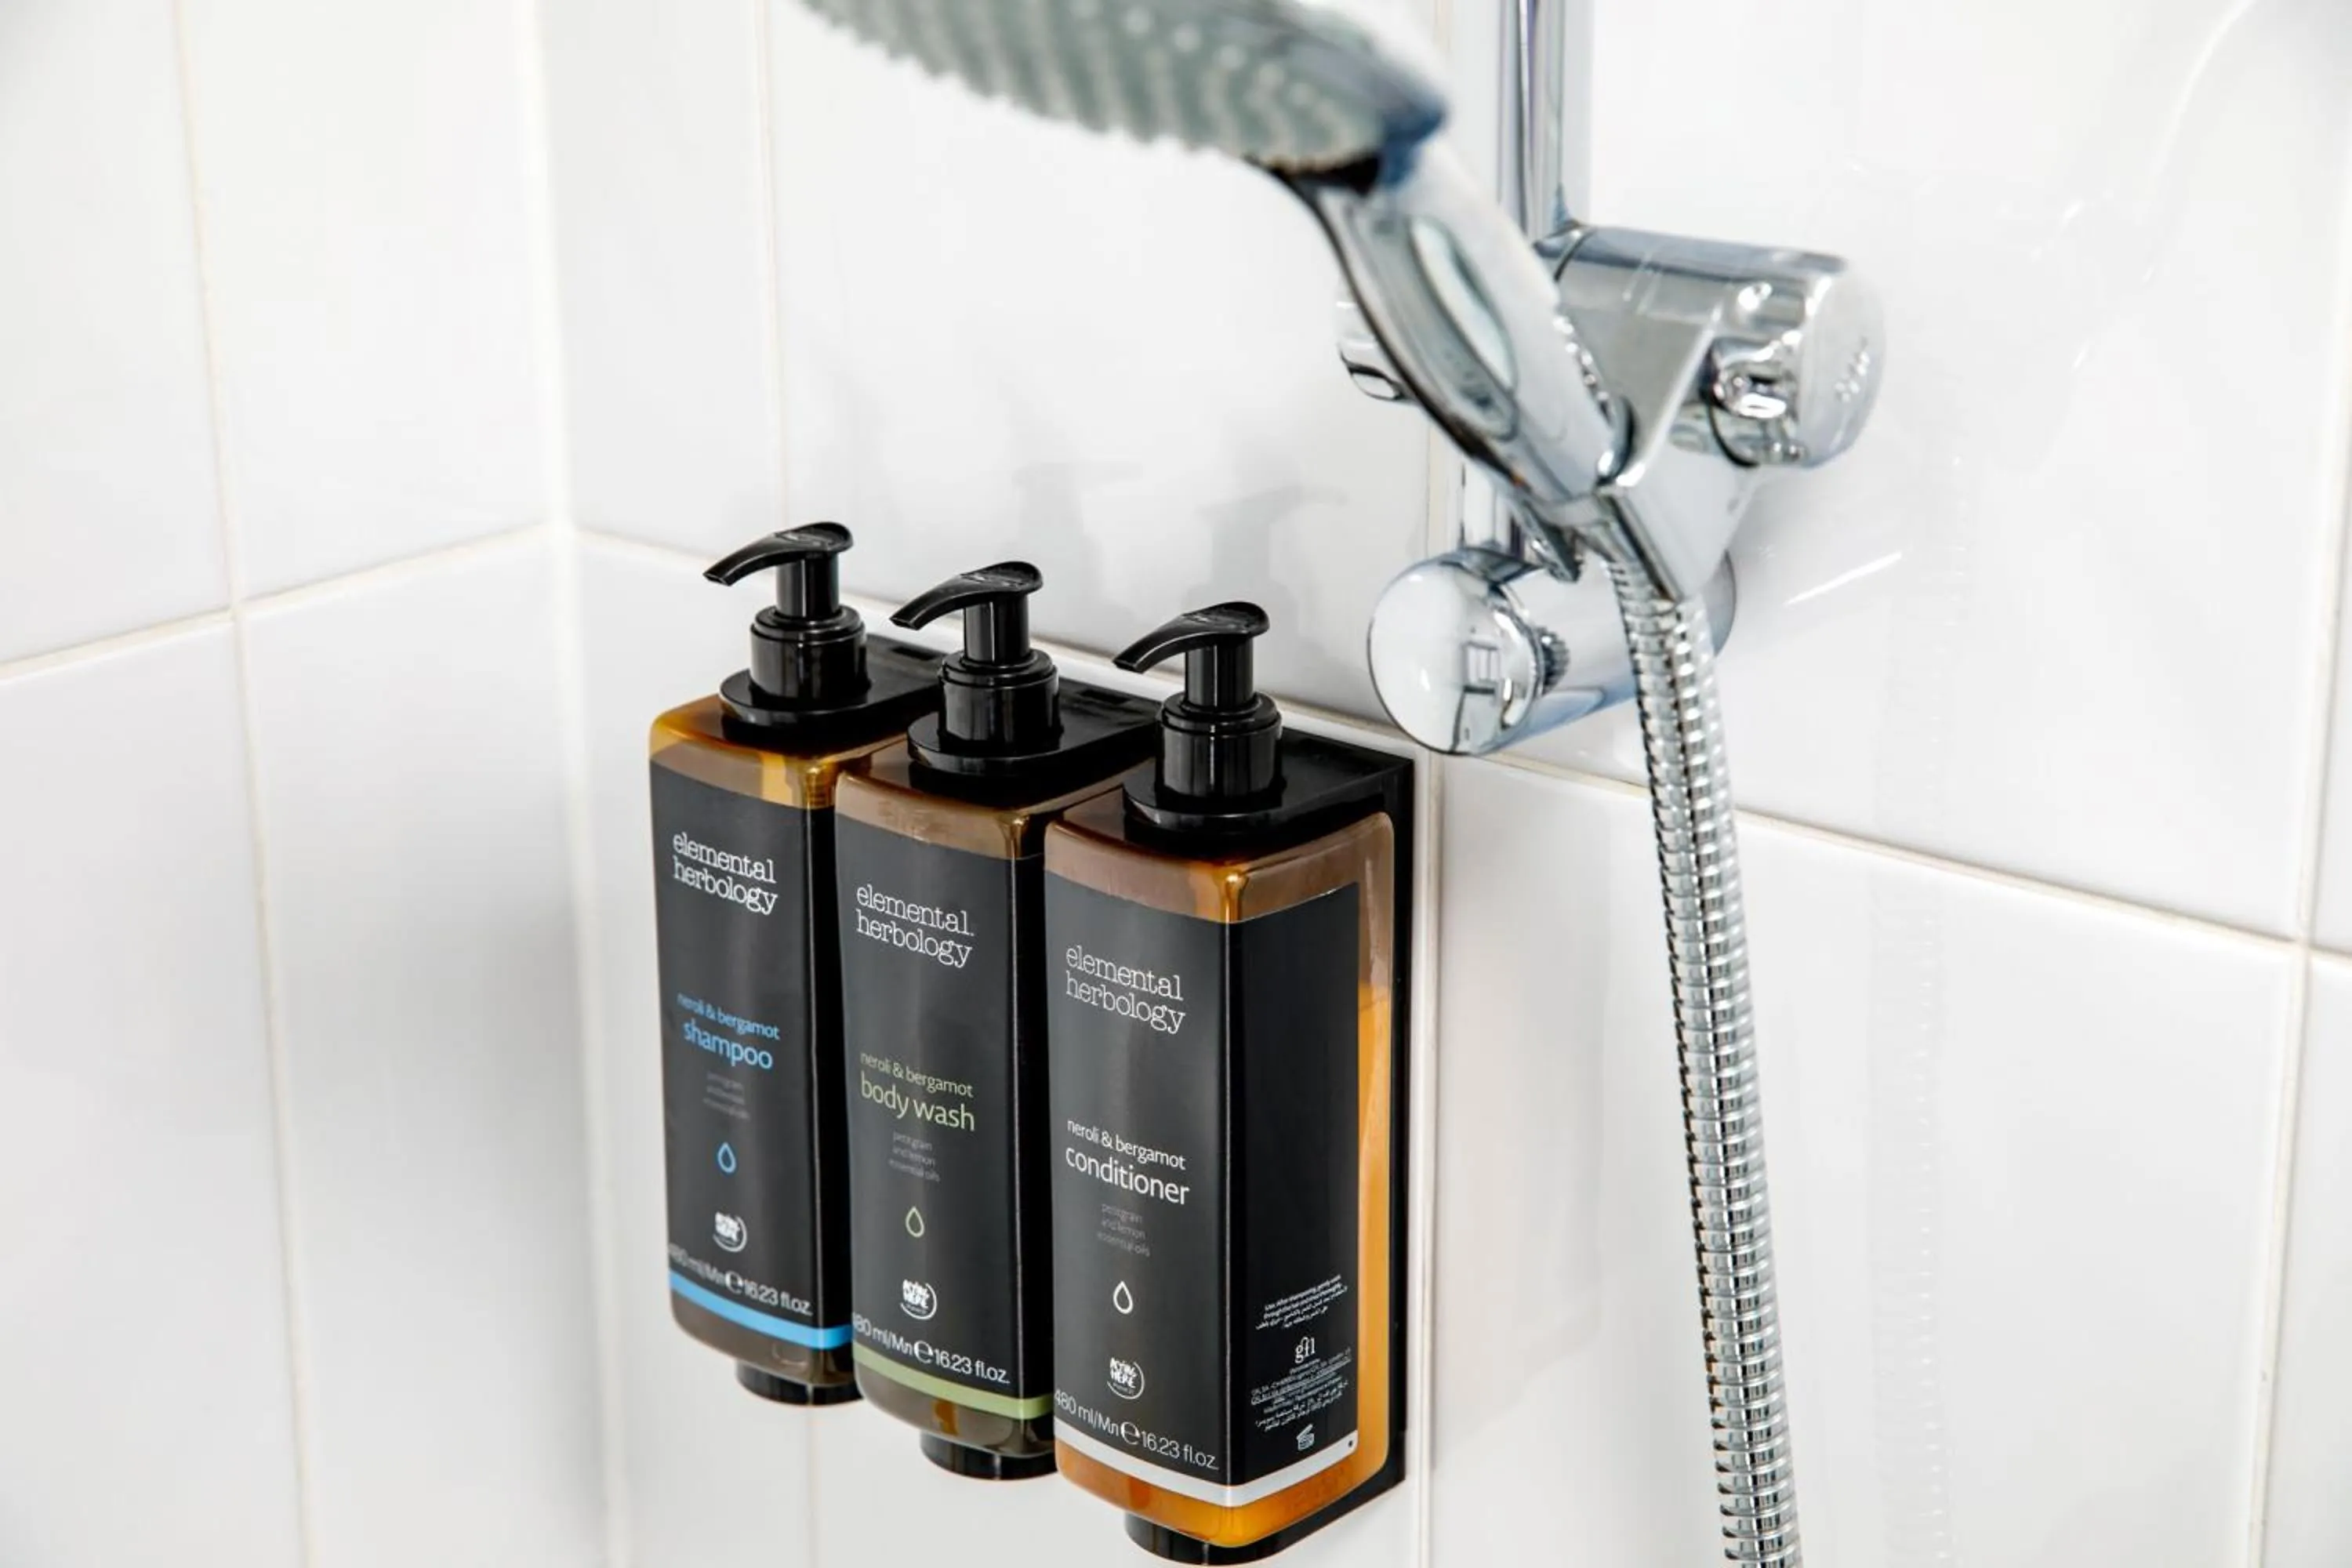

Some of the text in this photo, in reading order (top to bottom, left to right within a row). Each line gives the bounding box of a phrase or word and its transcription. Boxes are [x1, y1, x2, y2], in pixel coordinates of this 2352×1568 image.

[673, 832, 776, 884] elemental
[673, 855, 778, 916] herbology
[856, 884, 975, 937] elemental
[856, 909, 972, 968] herbology
[1065, 945, 1184, 1001] elemental
[717, 1006, 780, 1040] bergamot
[1065, 970, 1185, 1034] herbology
[684, 1018, 773, 1069] shampoo
[861, 1052, 974, 1098] neroli & bergamot
[861, 1069, 975, 1132] body wash
[1067, 1120, 1186, 1171] neroli & bergamot
[1065, 1147, 1190, 1205] conditioner
[1054, 1388, 1076, 1415] 480
